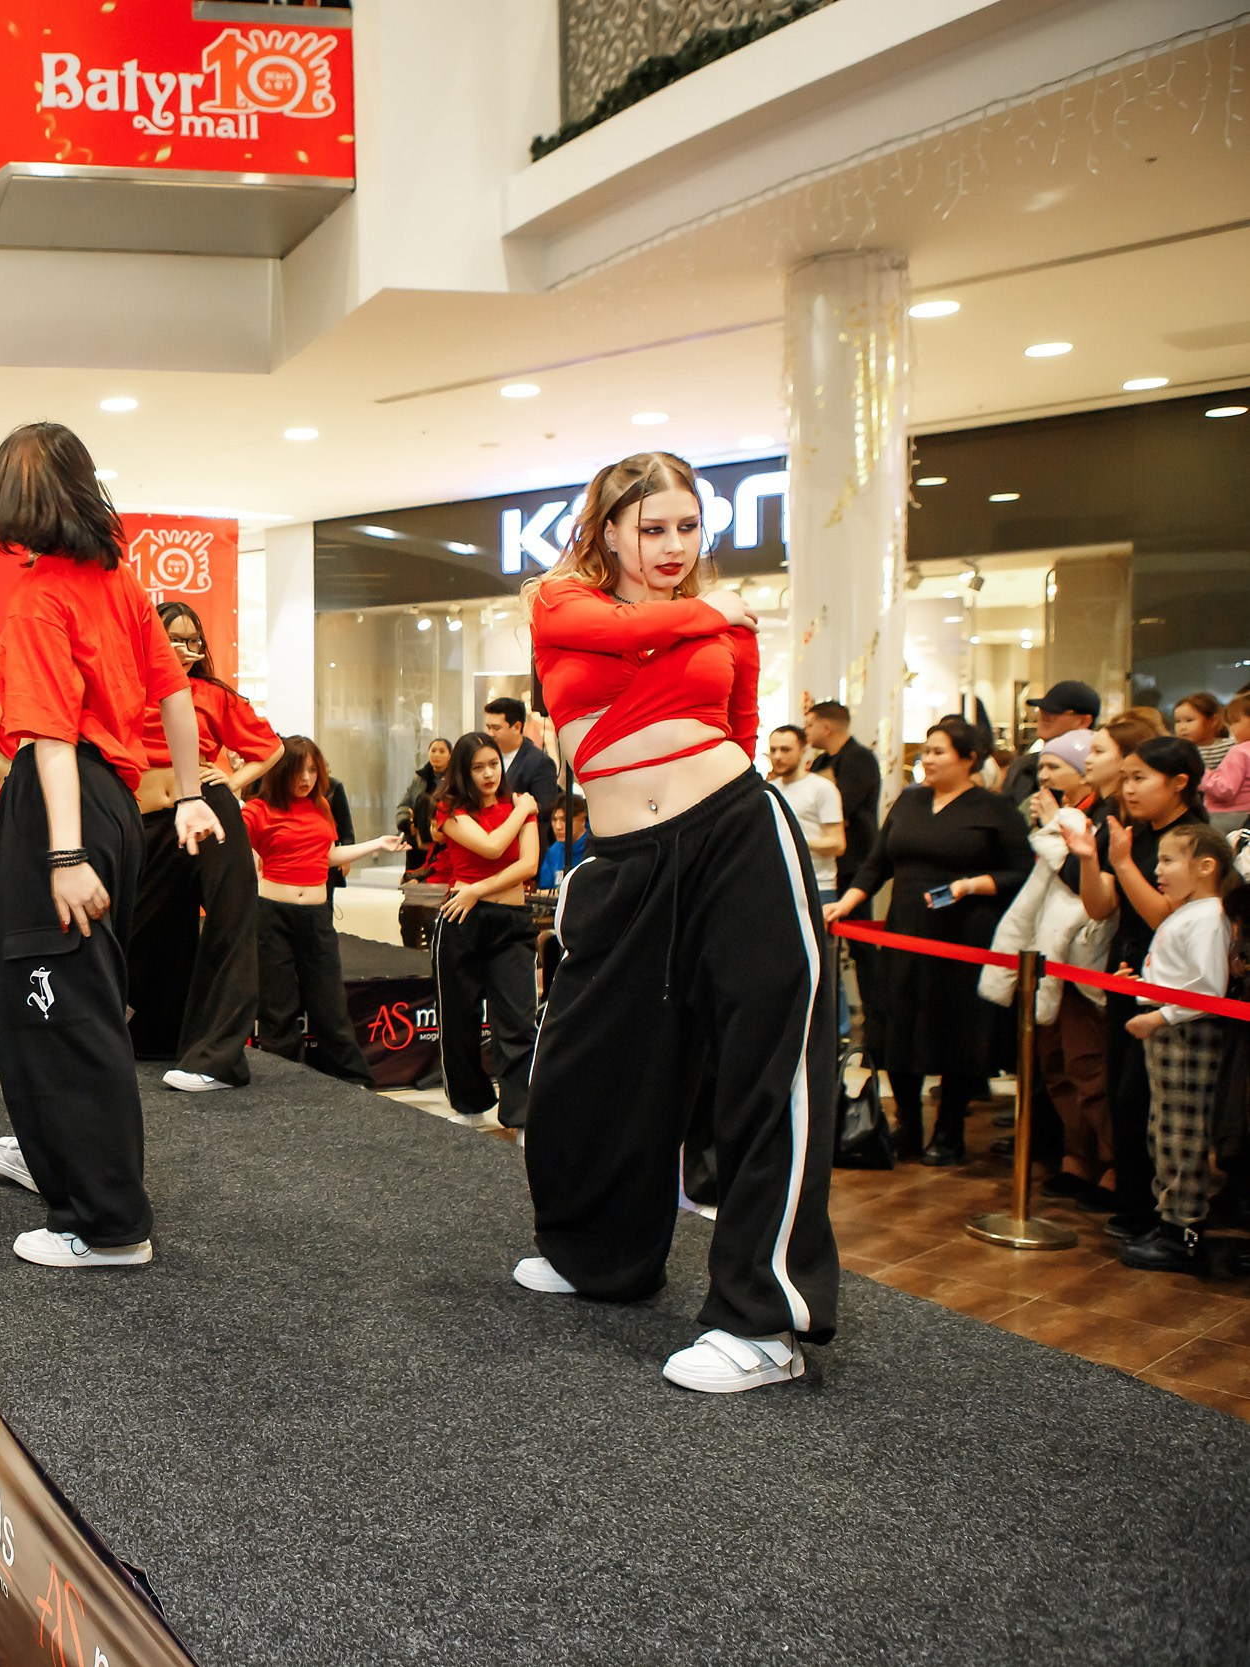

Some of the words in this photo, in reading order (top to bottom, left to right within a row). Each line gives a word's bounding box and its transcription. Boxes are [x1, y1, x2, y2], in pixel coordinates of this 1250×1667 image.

[41, 51, 205, 136] Batyr
[180, 114, 259, 140] mall
[368, 1001, 414, 1050] AS
